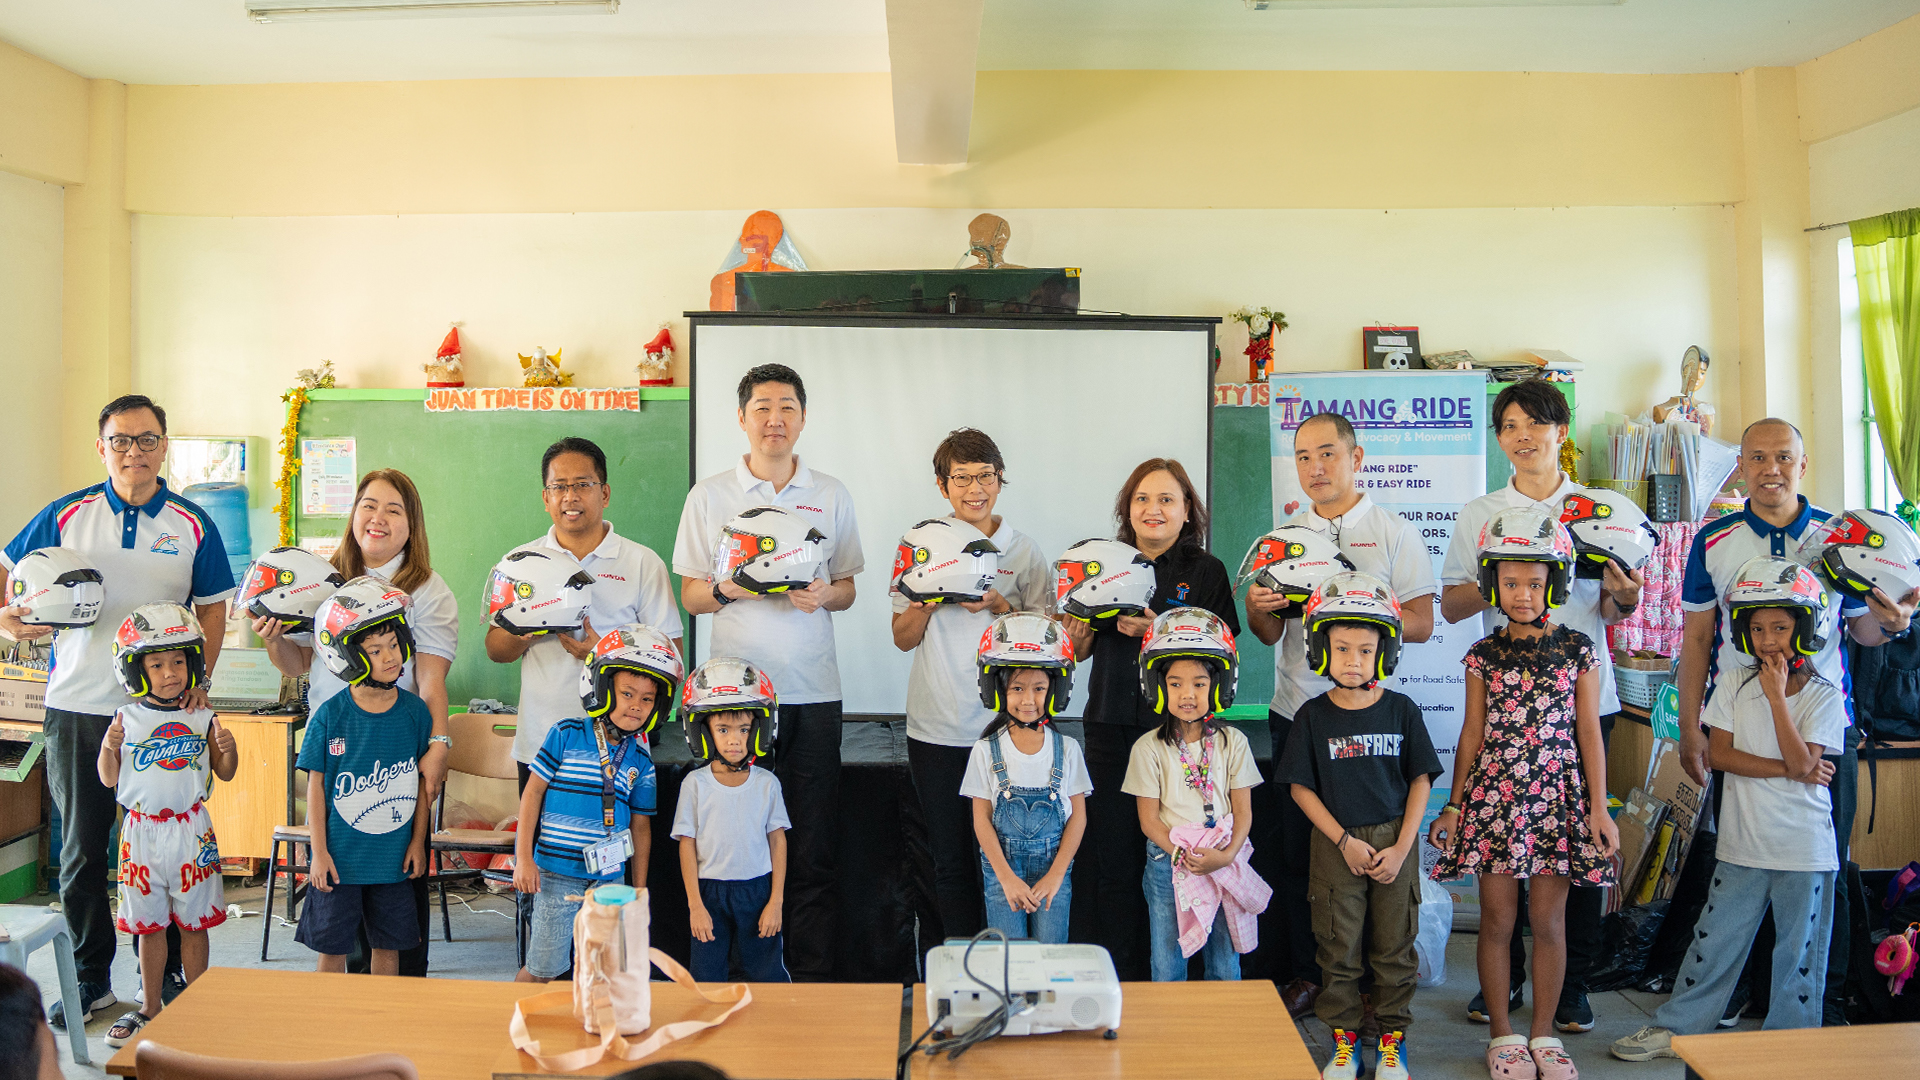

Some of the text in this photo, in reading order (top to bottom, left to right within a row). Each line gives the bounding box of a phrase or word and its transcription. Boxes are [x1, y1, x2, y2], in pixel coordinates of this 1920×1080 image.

[426, 388, 639, 411] JUAN TIME IS ON TIME
[1251, 384, 1269, 405] IS
[1276, 397, 1471, 424] TAMANG RIDE
[1357, 431, 1401, 444] dvocacy
[1404, 432, 1412, 442] &
[1415, 431, 1472, 442] Movement
[1367, 480, 1374, 489] &
[1377, 480, 1404, 489] EASY
[1406, 480, 1431, 489] RIDE
[796, 505, 824, 513] HONDA
[1419, 528, 1450, 539] ORS,
[1605, 525, 1636, 535] HONDA
[773, 547, 803, 562] HONDA
[928, 558, 959, 573] HONDA
[1874, 556, 1908, 571] HONDA
[597, 573, 626, 582] HONDA
[1100, 570, 1131, 586] HONDA
[23, 588, 50, 604] HONDA
[289, 583, 321, 595] HONDA
[531, 597, 563, 611] HONDA
[1409, 675, 1421, 684] for
[1423, 675, 1444, 684] Road
[1418, 702, 1455, 712] ducation
[133, 740, 207, 771] CAVALIERS
[330, 744, 345, 755] NFL
[335, 757, 415, 800] Dodgers
[391, 806, 402, 823] LA
